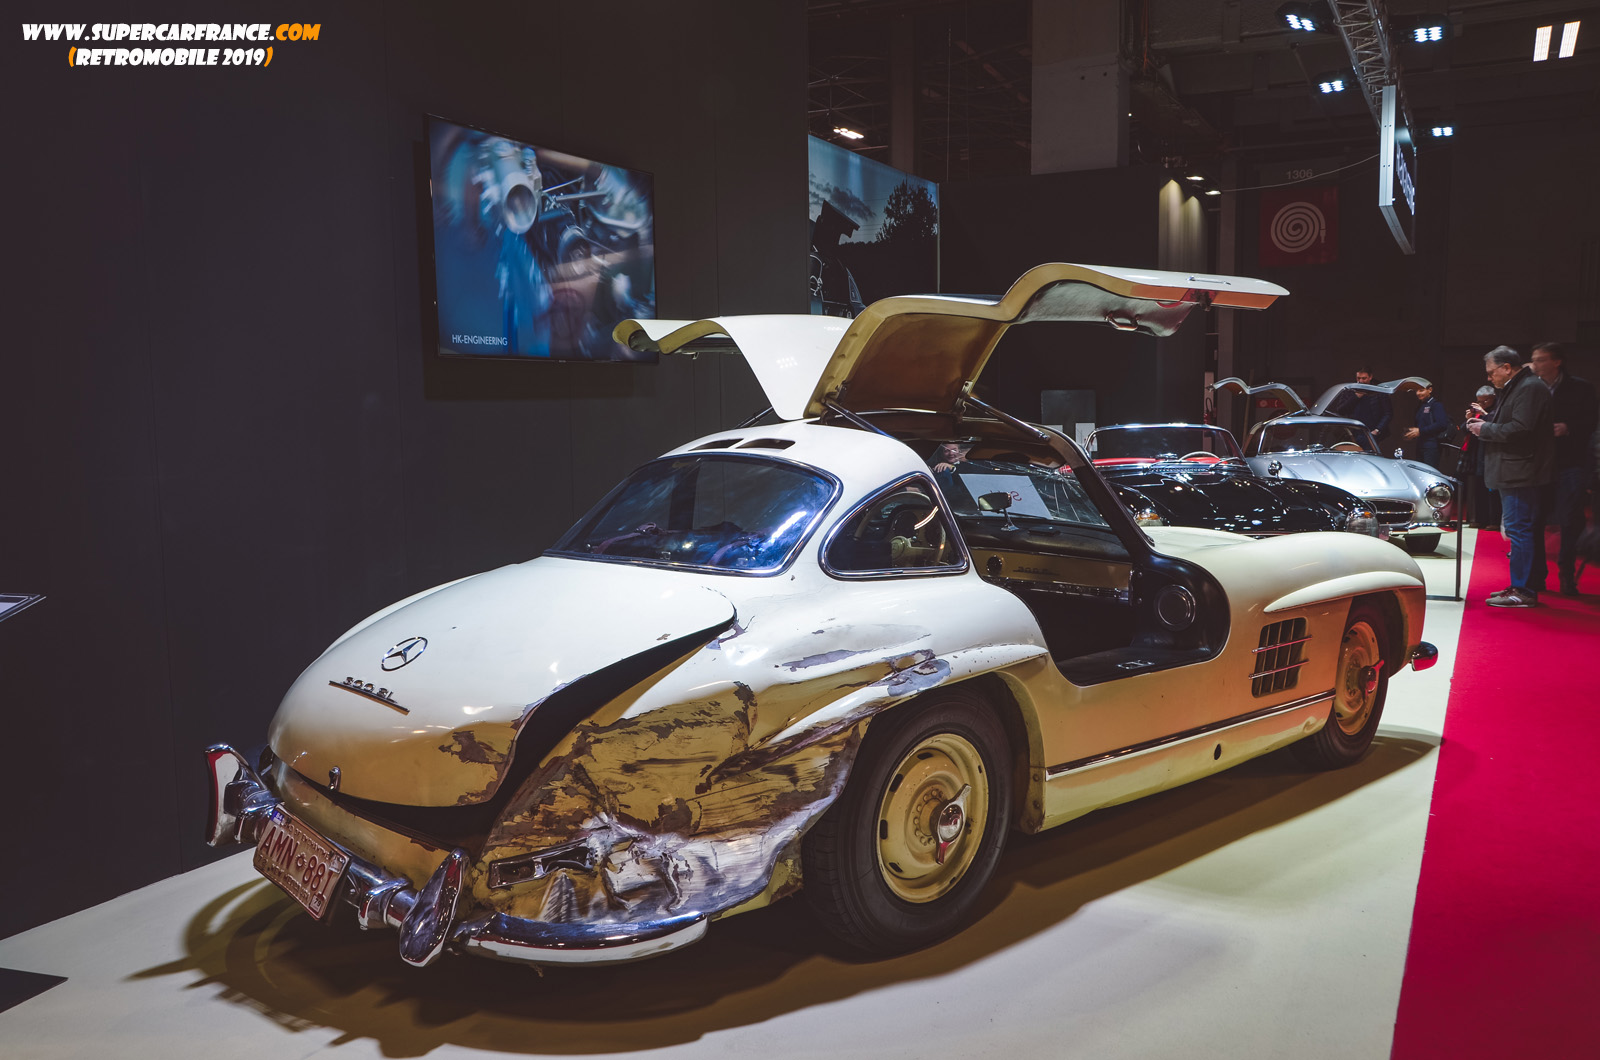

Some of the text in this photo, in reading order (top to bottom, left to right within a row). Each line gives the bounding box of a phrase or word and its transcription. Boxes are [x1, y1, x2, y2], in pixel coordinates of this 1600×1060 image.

[1287, 169, 1313, 179] 1306
[452, 334, 508, 346] HK-ENGINEERING
[260, 825, 300, 870] AMN
